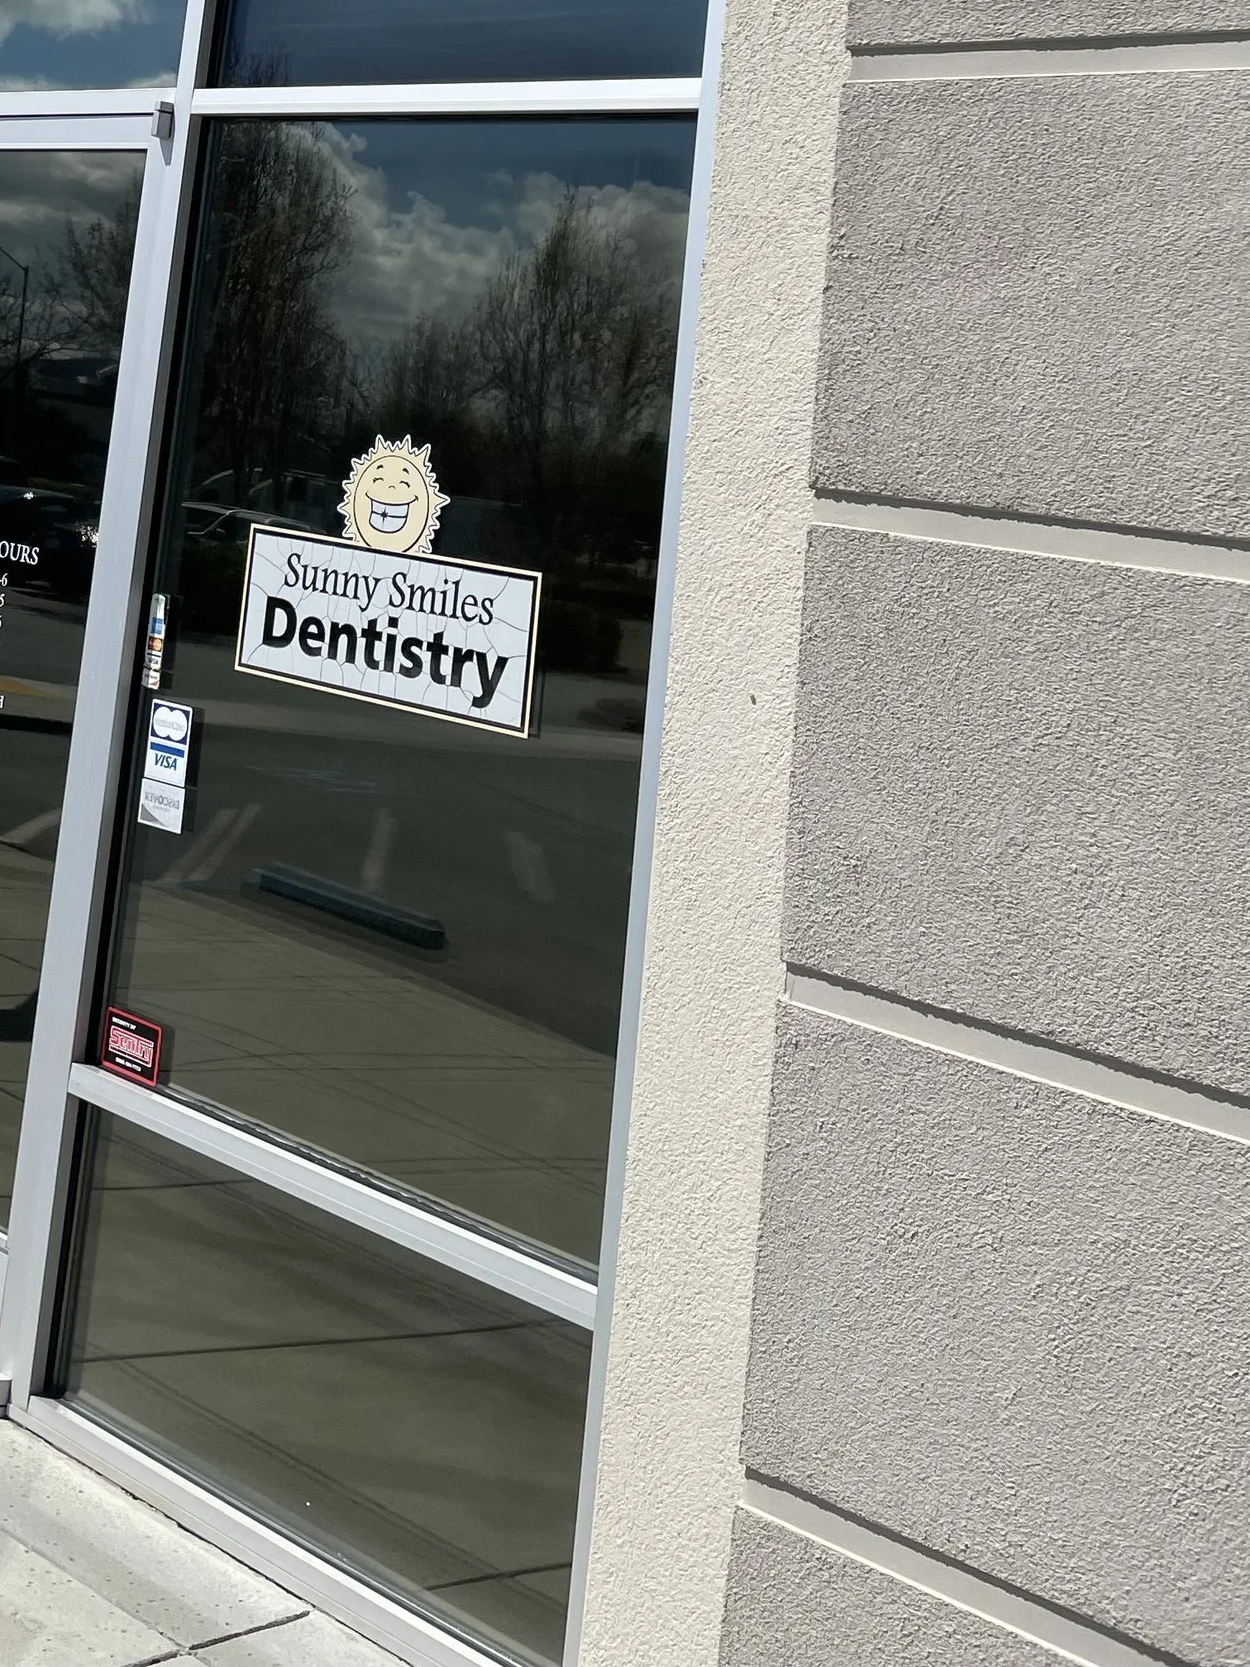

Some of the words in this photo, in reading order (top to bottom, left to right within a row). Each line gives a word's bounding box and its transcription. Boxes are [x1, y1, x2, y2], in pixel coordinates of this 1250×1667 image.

[284, 552, 382, 612] Sunny
[388, 571, 494, 625] Smiles
[262, 595, 509, 708] Dentistry
[153, 752, 178, 771] VISA
